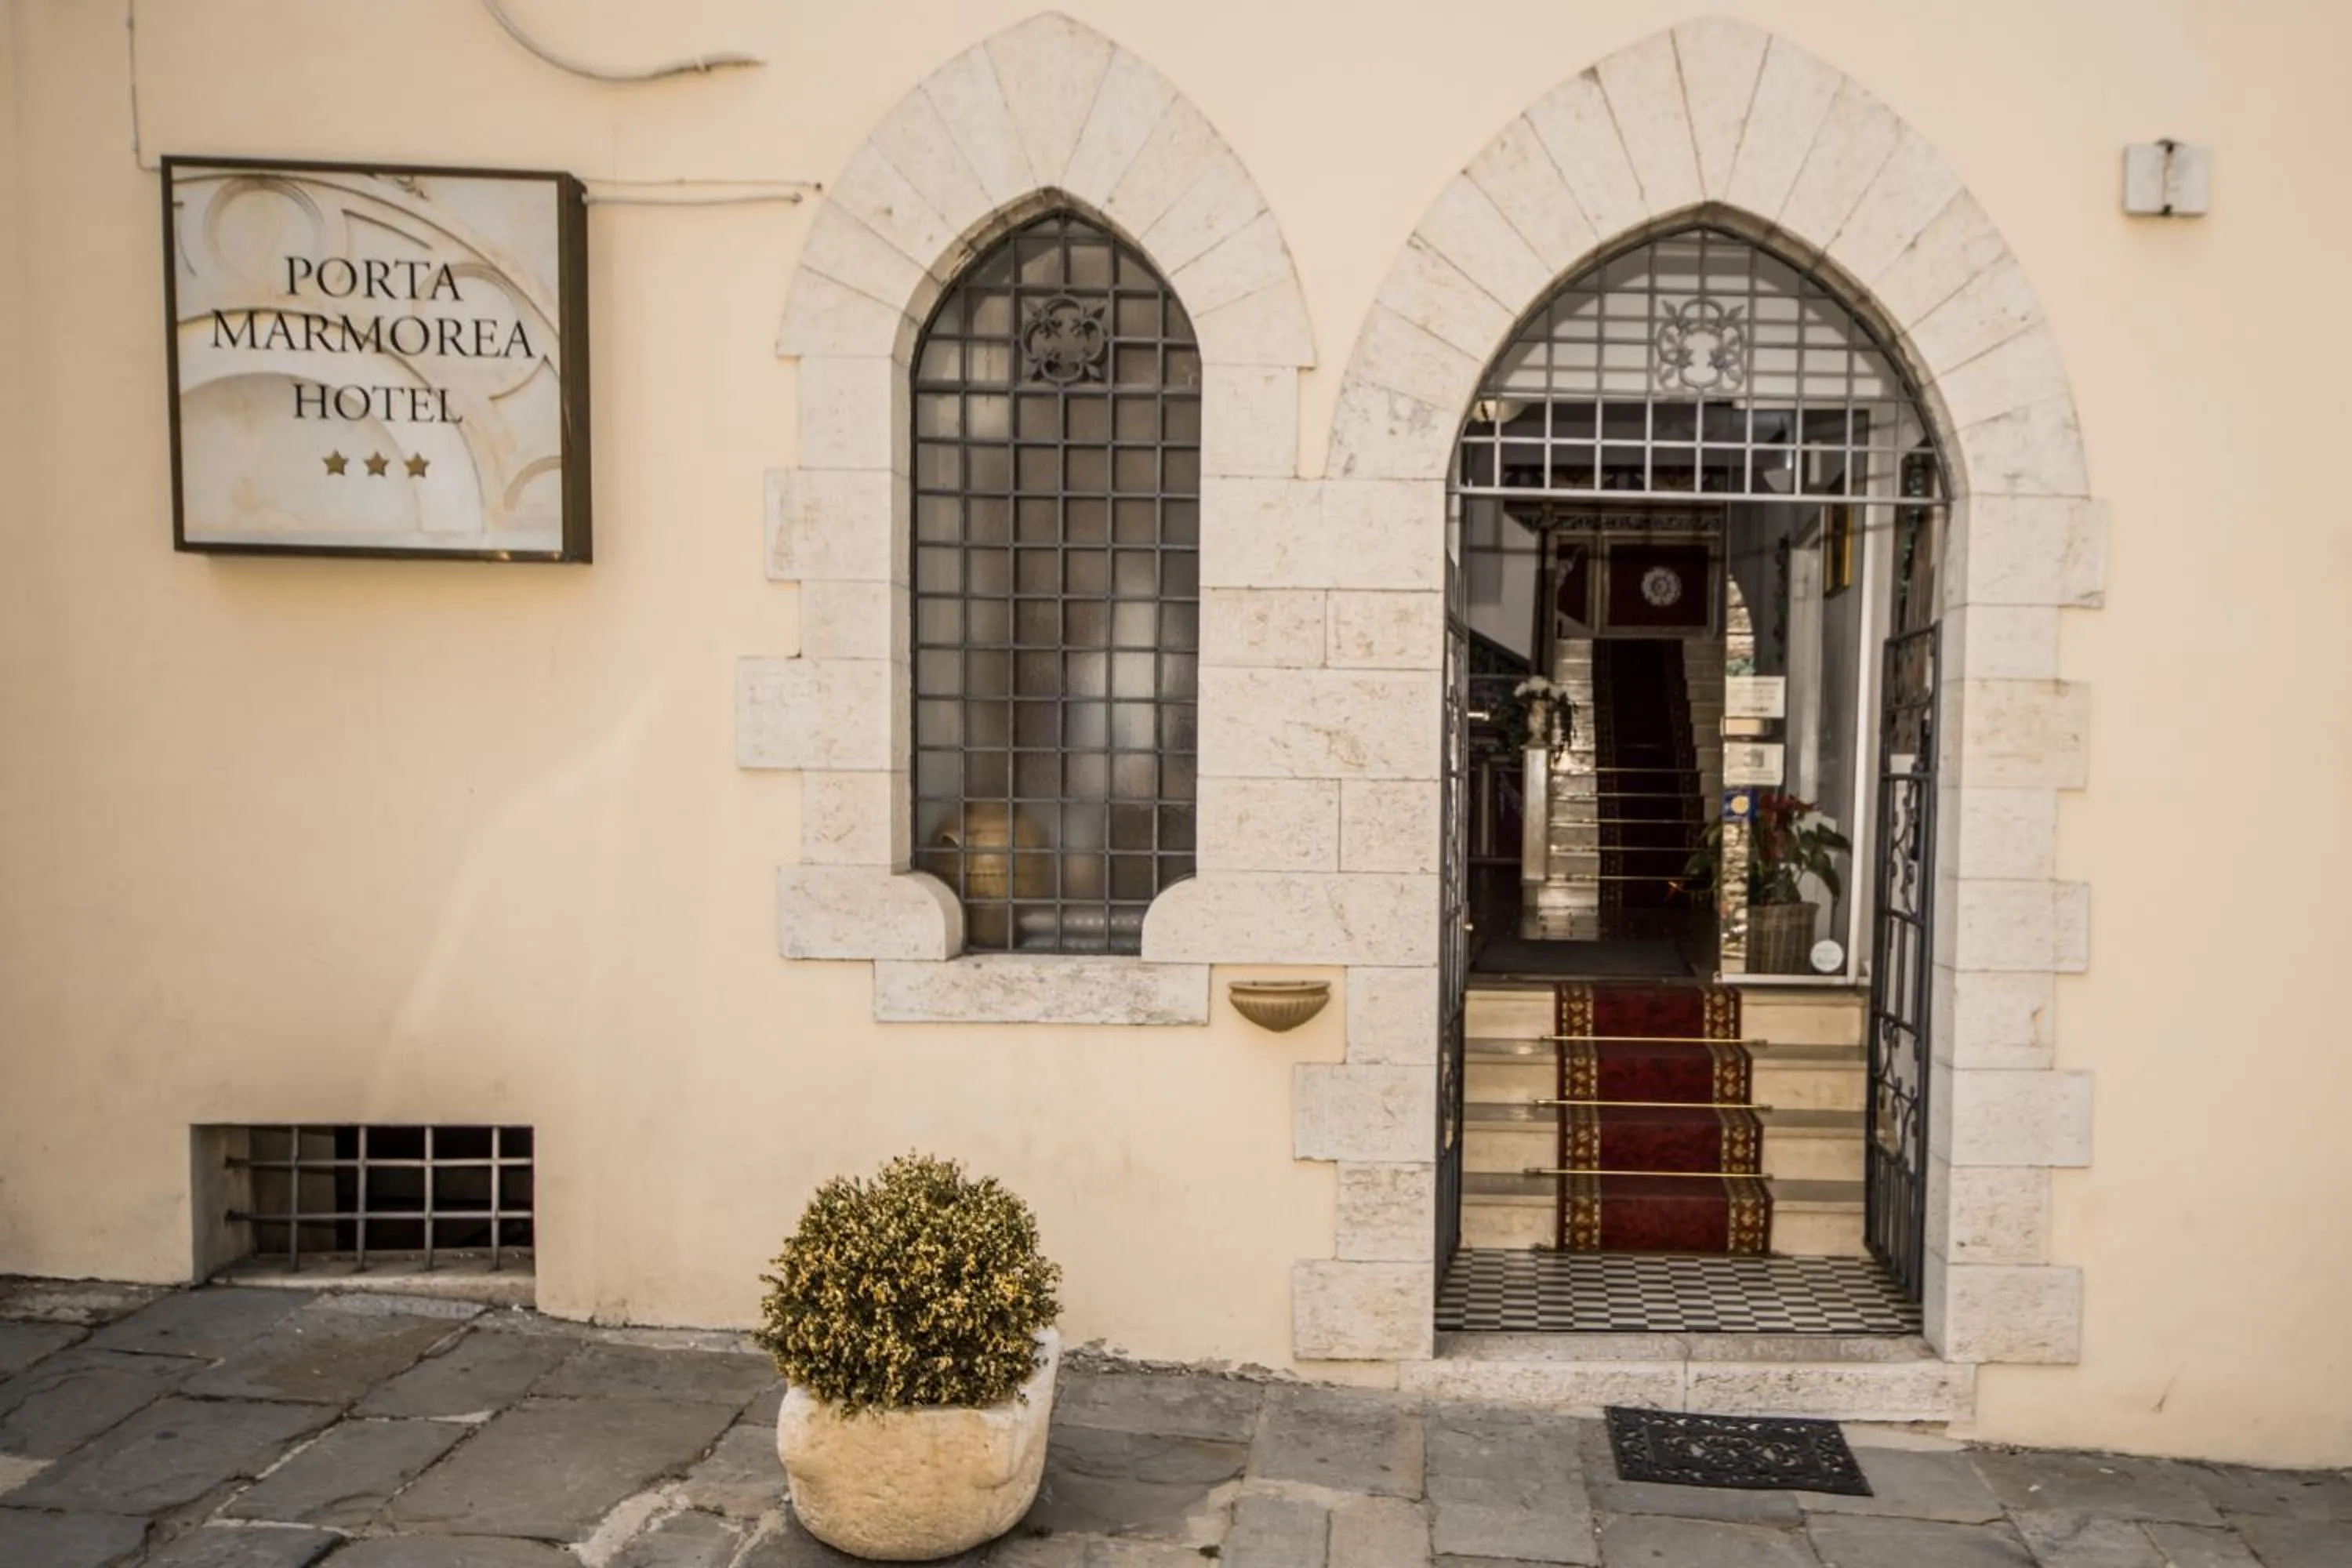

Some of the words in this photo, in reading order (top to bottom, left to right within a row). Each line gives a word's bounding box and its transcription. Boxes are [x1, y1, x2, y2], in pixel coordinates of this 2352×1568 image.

[285, 256, 464, 301] PORTA
[211, 309, 535, 358] MARMOREA
[292, 384, 463, 423] HOTEL
